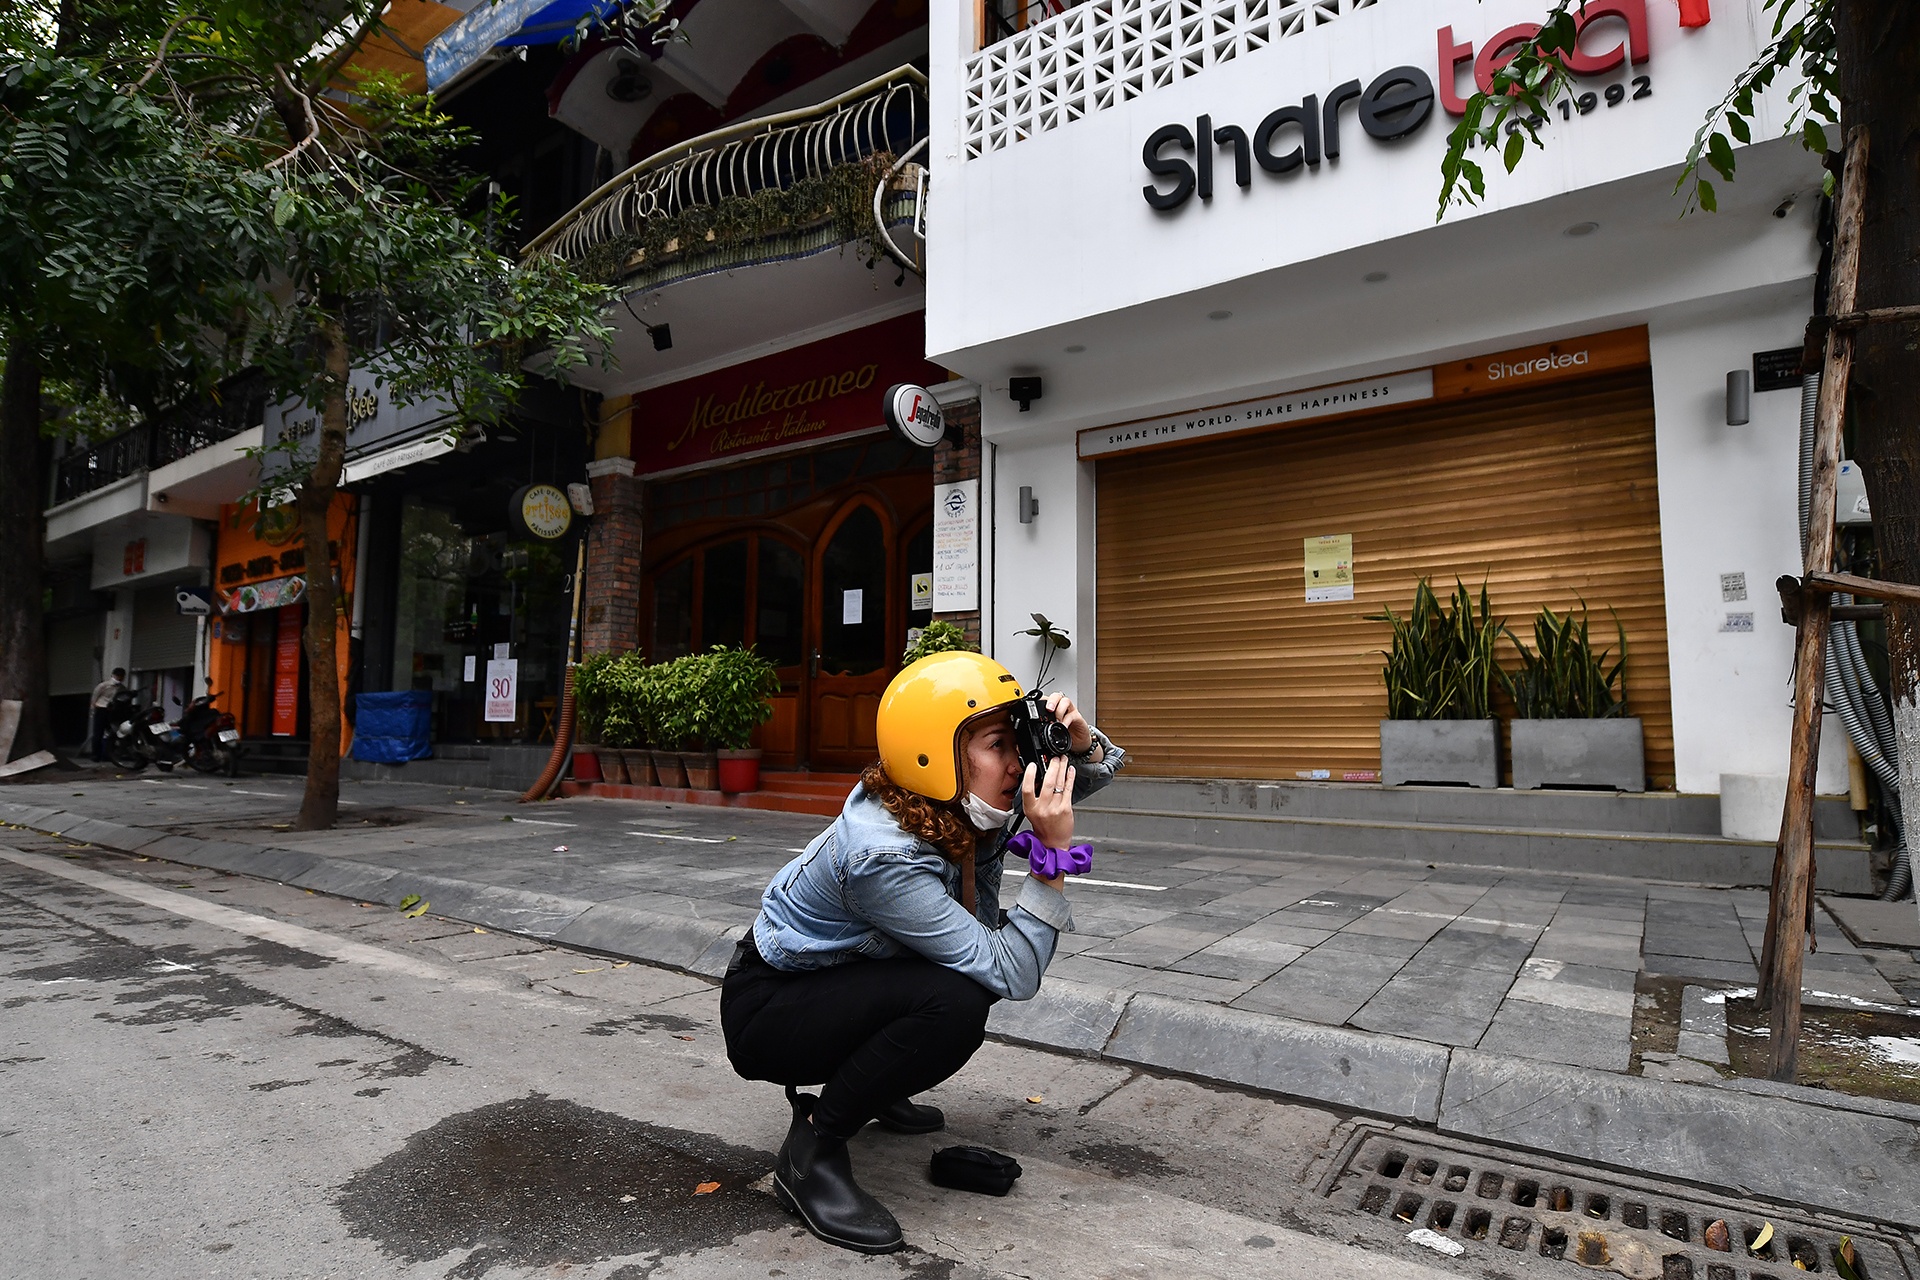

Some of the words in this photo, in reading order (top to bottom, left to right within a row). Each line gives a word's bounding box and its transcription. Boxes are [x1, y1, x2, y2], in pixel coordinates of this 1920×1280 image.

[1557, 75, 1653, 121] 1992
[1487, 349, 1589, 381] Sharetea
[667, 363, 879, 452] Mediterraneo
[1108, 429, 1149, 445] SHARE
[1154, 423, 1178, 437] THE
[1185, 414, 1239, 431] WORLD.
[1246, 403, 1293, 421] SHARE
[1301, 386, 1391, 411] HAPPINESS
[710, 420, 772, 454] Ristorante
[774, 409, 828, 441] Italiano
[525, 496, 568, 523] artisée
[546, 488, 562, 502] DELI
